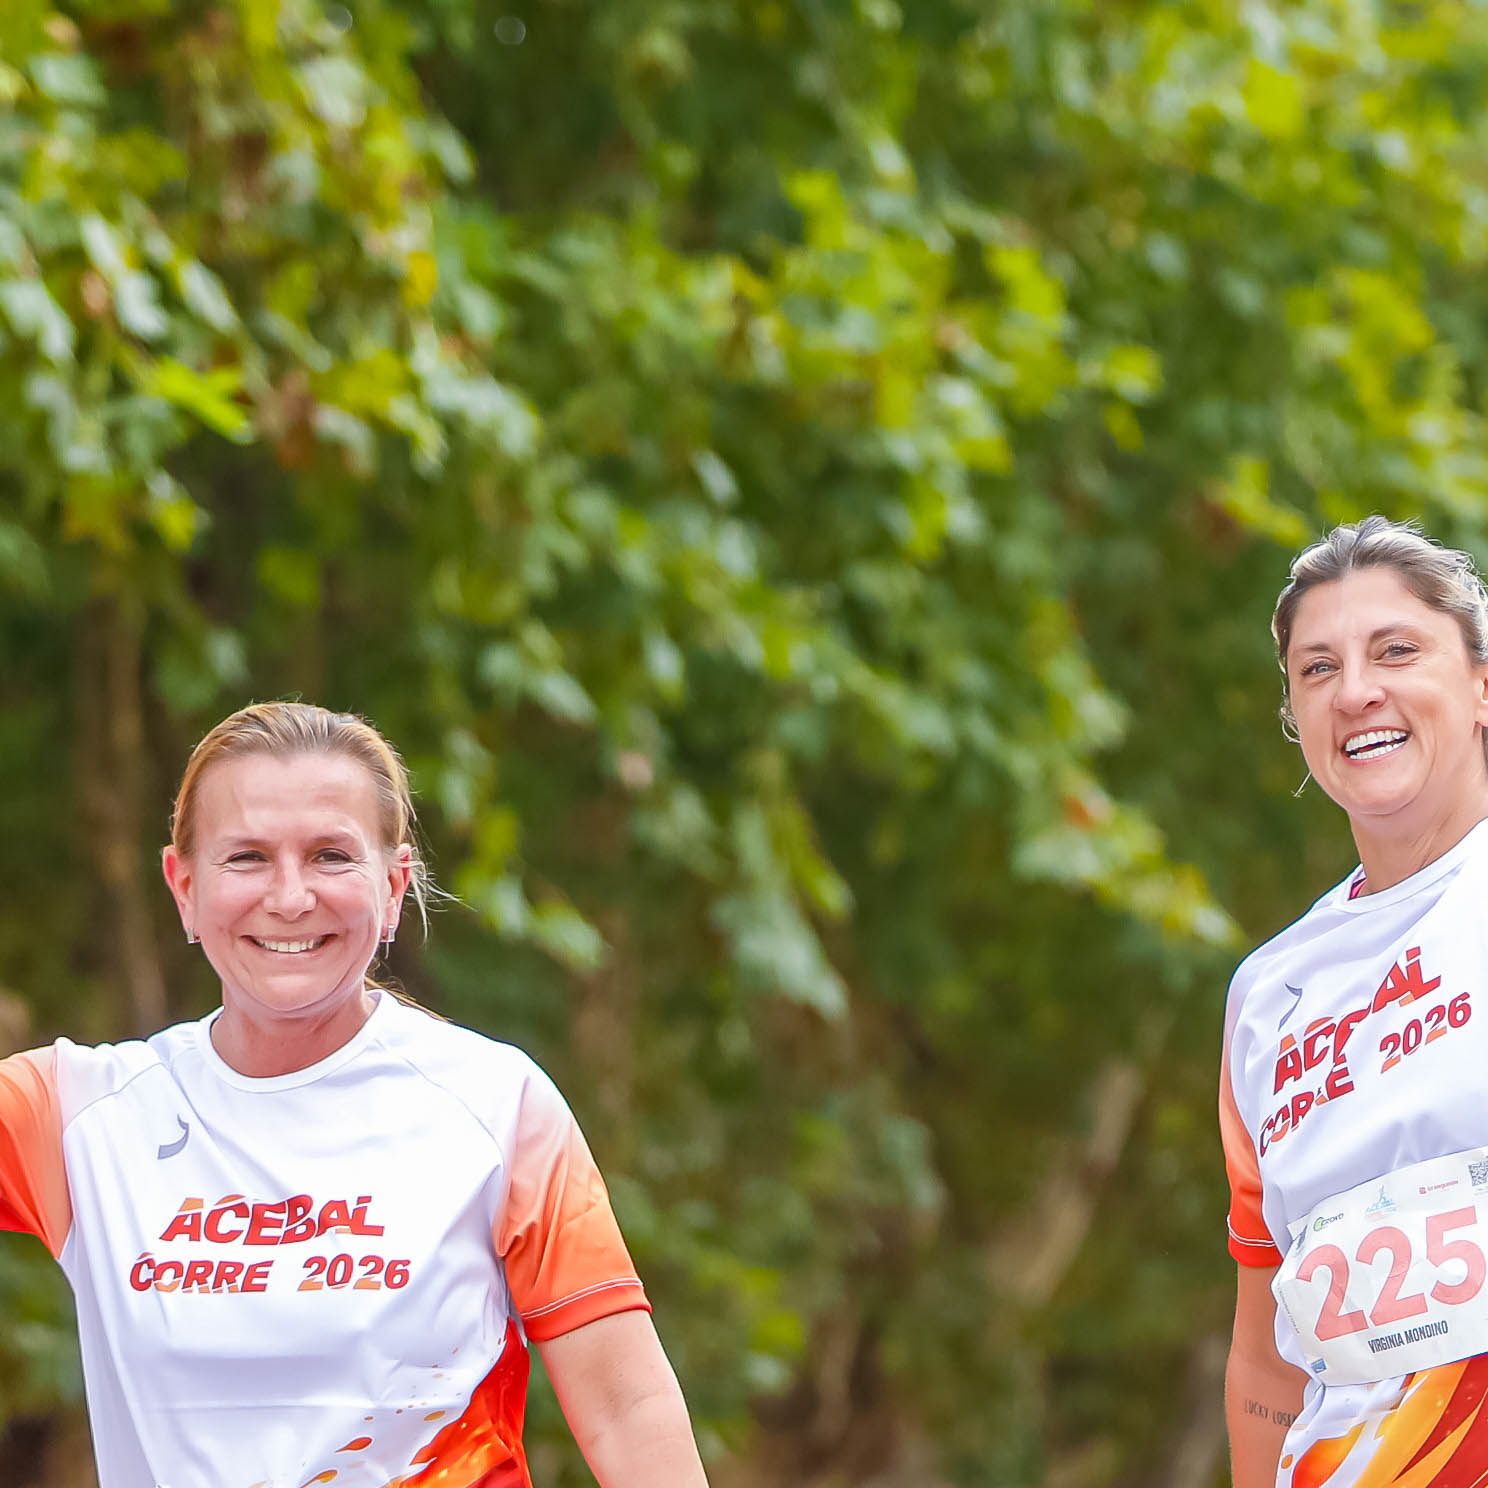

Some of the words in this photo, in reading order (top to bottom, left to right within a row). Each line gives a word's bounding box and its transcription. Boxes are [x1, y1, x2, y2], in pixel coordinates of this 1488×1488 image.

[1379, 992, 1472, 1075] 2026
[159, 1194, 385, 1246] ACEBAL
[130, 1252, 275, 1293] CORRE
[297, 1253, 411, 1291] 2026
[1296, 1205, 1487, 1342] 225
[1367, 1332, 1405, 1354] VIRGINIA
[1405, 1320, 1449, 1343] MONDINO
